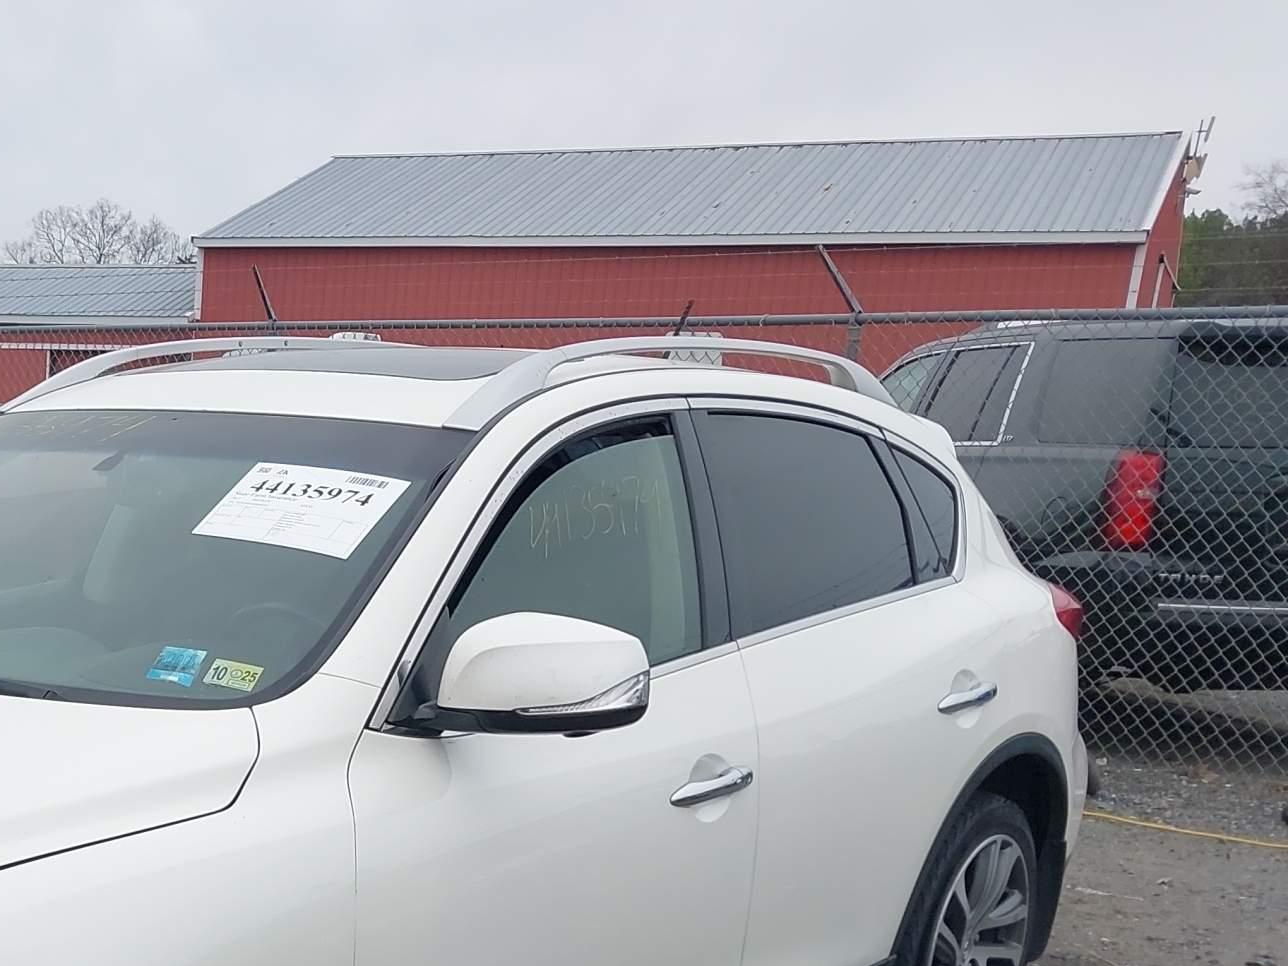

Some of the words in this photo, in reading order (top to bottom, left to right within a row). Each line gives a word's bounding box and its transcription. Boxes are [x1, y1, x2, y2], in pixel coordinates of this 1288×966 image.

[249, 478, 376, 507] 44135974
[210, 665, 229, 682] 10
[240, 670, 259, 683] 25
